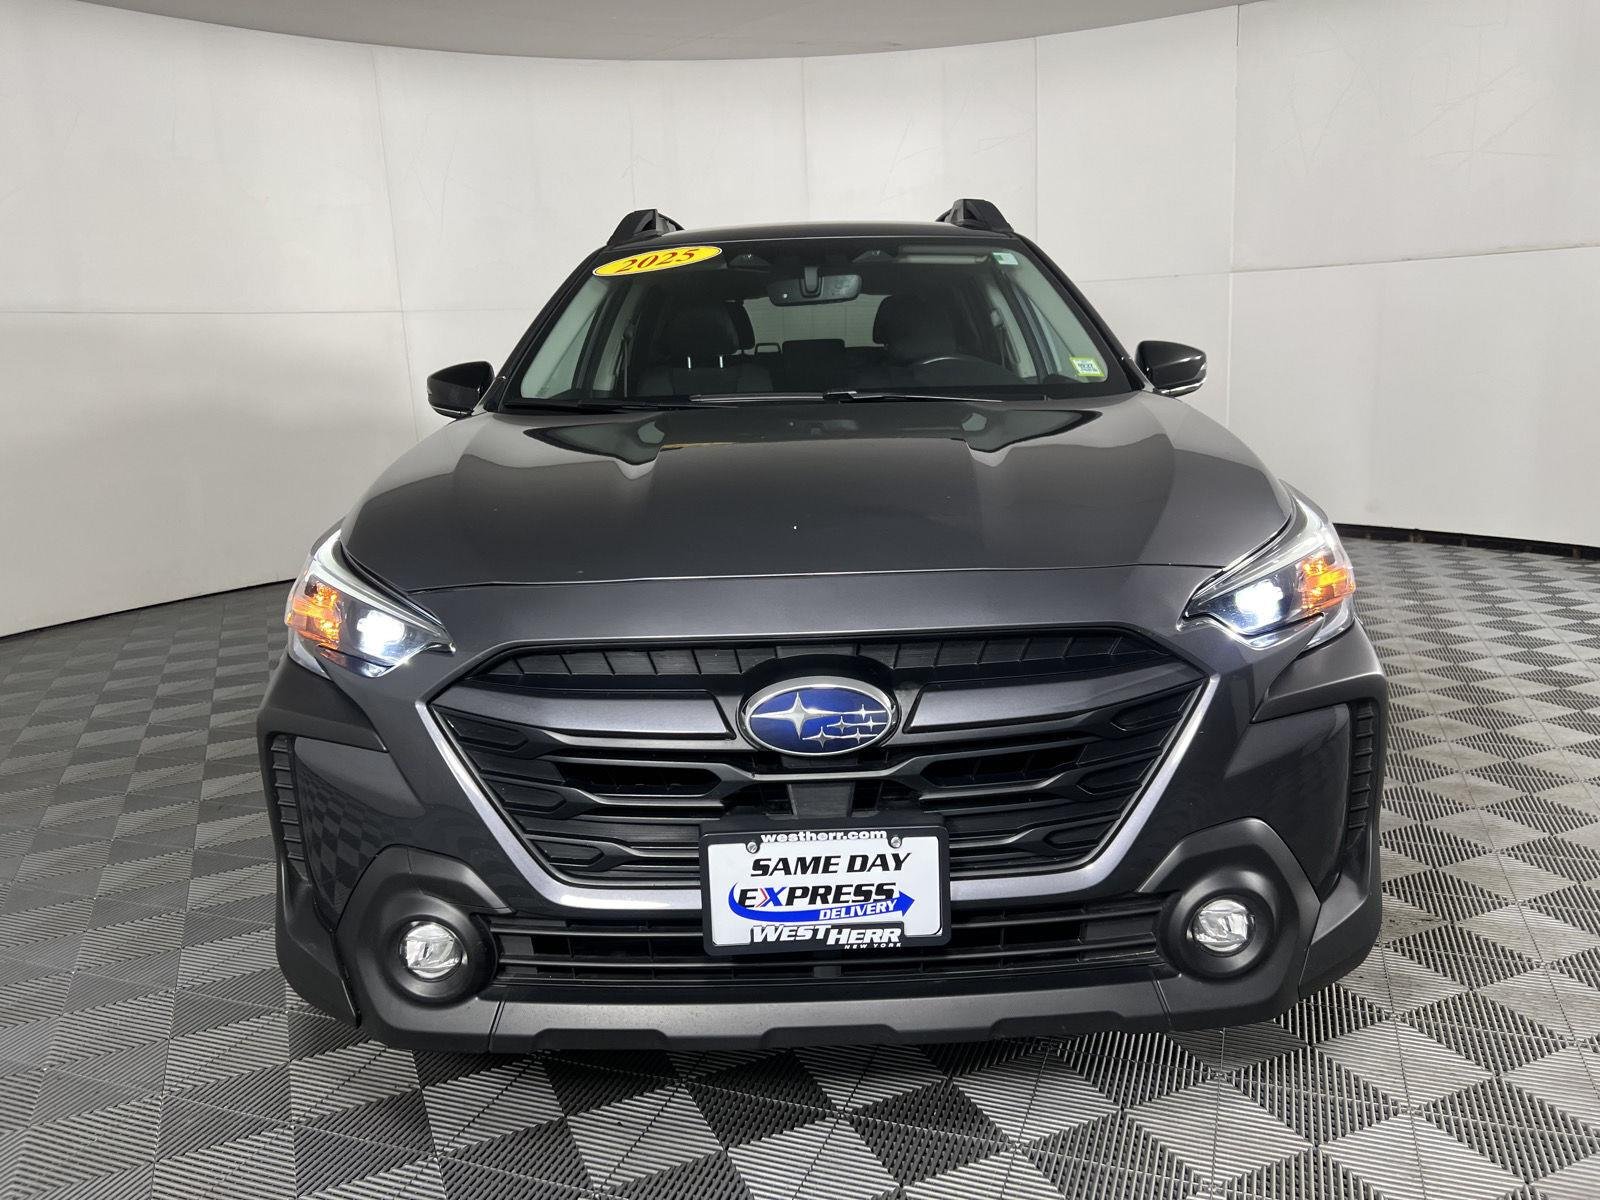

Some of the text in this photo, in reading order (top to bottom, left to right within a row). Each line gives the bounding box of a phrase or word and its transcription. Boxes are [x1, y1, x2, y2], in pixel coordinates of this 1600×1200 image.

[614, 249, 699, 273] 2025
[760, 830, 887, 843] westherr.com
[750, 852, 912, 877] SAME DAY
[738, 882, 896, 908] EXPRESS
[818, 899, 898, 921] DELIVERY
